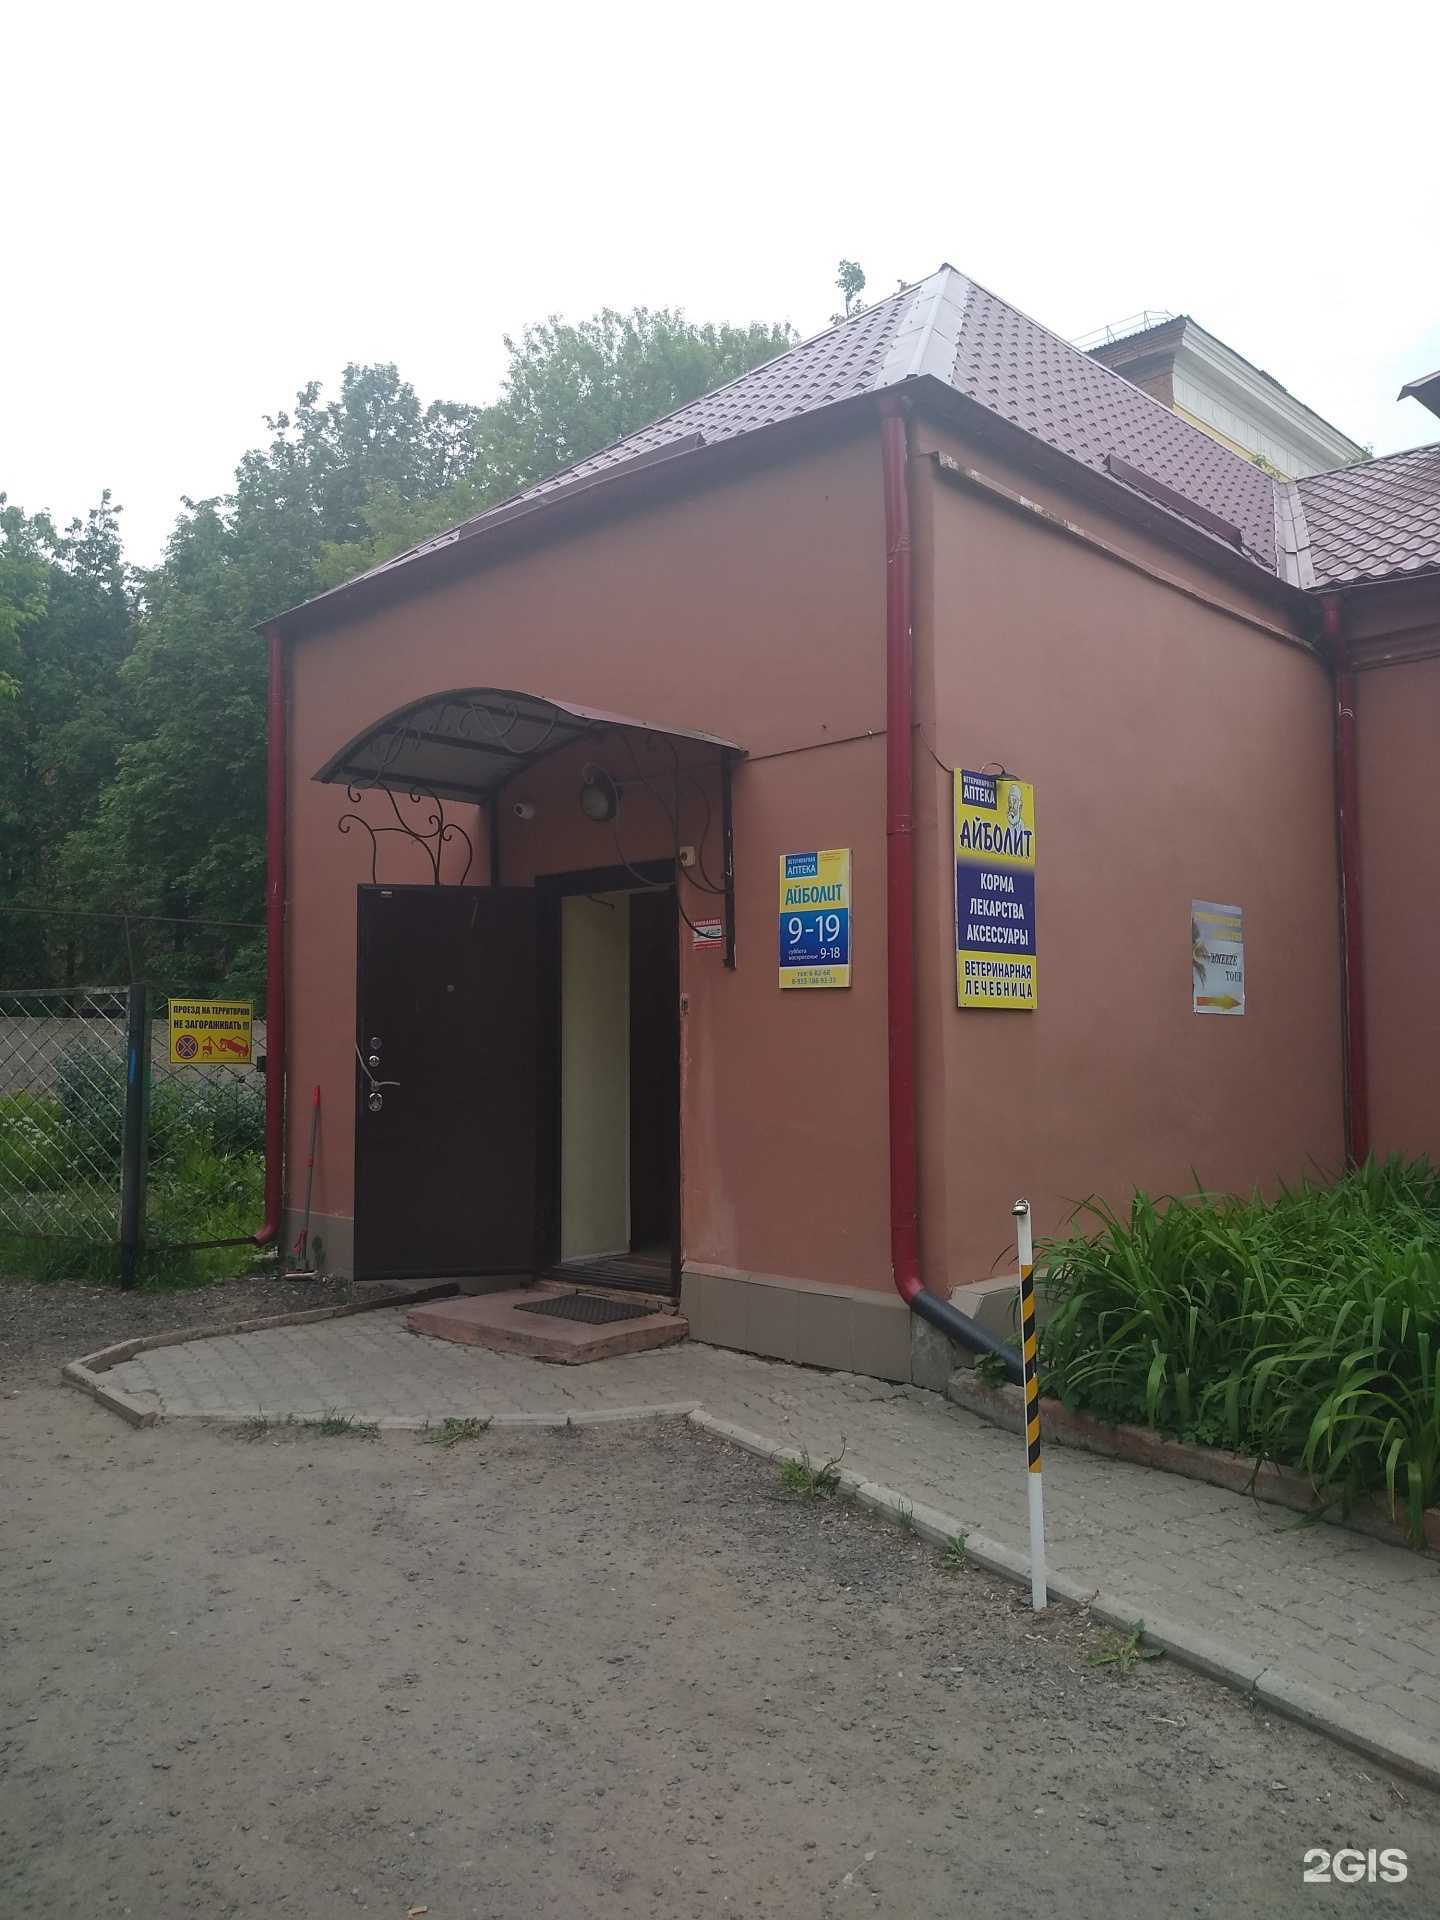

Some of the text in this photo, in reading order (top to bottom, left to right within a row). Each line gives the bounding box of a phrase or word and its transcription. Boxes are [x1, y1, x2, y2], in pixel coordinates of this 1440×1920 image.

[963, 784, 996, 804] АПТЕКА
[960, 816, 1033, 857] АЙБОЛИТ
[788, 864, 816, 875] АПТЕКА
[980, 872, 1015, 893] КОРМА
[785, 884, 842, 905] АЙБОЛИТ
[969, 898, 1025, 920] ЛЕКАРСТВА
[788, 914, 840, 944] 9-19
[966, 924, 1029, 945] АКСЕССУАРЫ
[820, 946, 840, 959] 9-18
[964, 960, 1032, 979] ВЕТЕРИНАРНАЯ
[965, 980, 1033, 999] ЛЕЧЕБНИЦА
[173, 1005, 200, 1015] ПРОЕЗД
[202, 1006, 210, 1014] НА
[174, 1019, 184, 1028] НЕ
[185, 1020, 241, 1030] ЗАГОРАЖИВАТЬ
